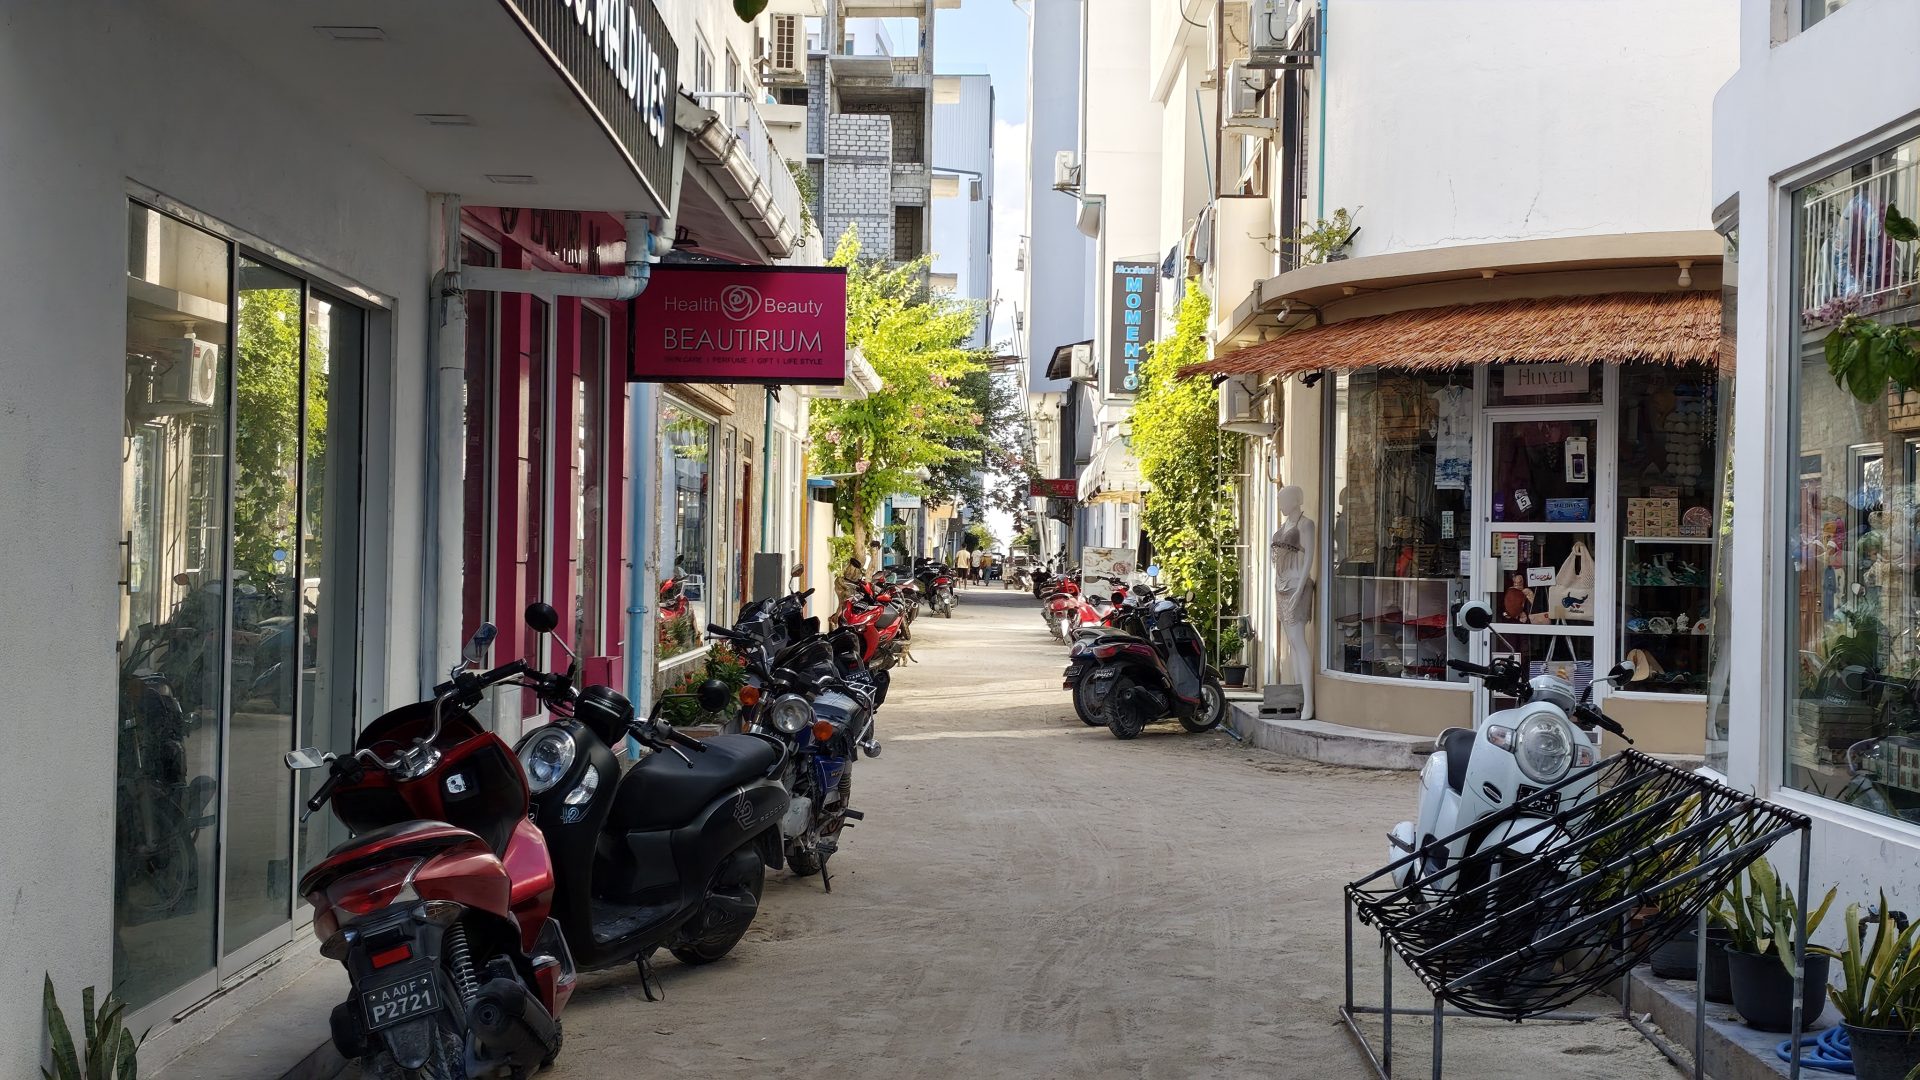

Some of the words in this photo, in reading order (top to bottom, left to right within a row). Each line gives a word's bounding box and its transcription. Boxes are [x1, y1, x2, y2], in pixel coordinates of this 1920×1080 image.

[664, 296, 719, 312] Health
[764, 298, 823, 318] Beauty
[663, 327, 822, 352] BEAUTIRIUM
[1123, 276, 1143, 391] MOMENTO
[382, 990, 390, 1001] A
[409, 981, 417, 992] F
[372, 989, 432, 1023] P2721
